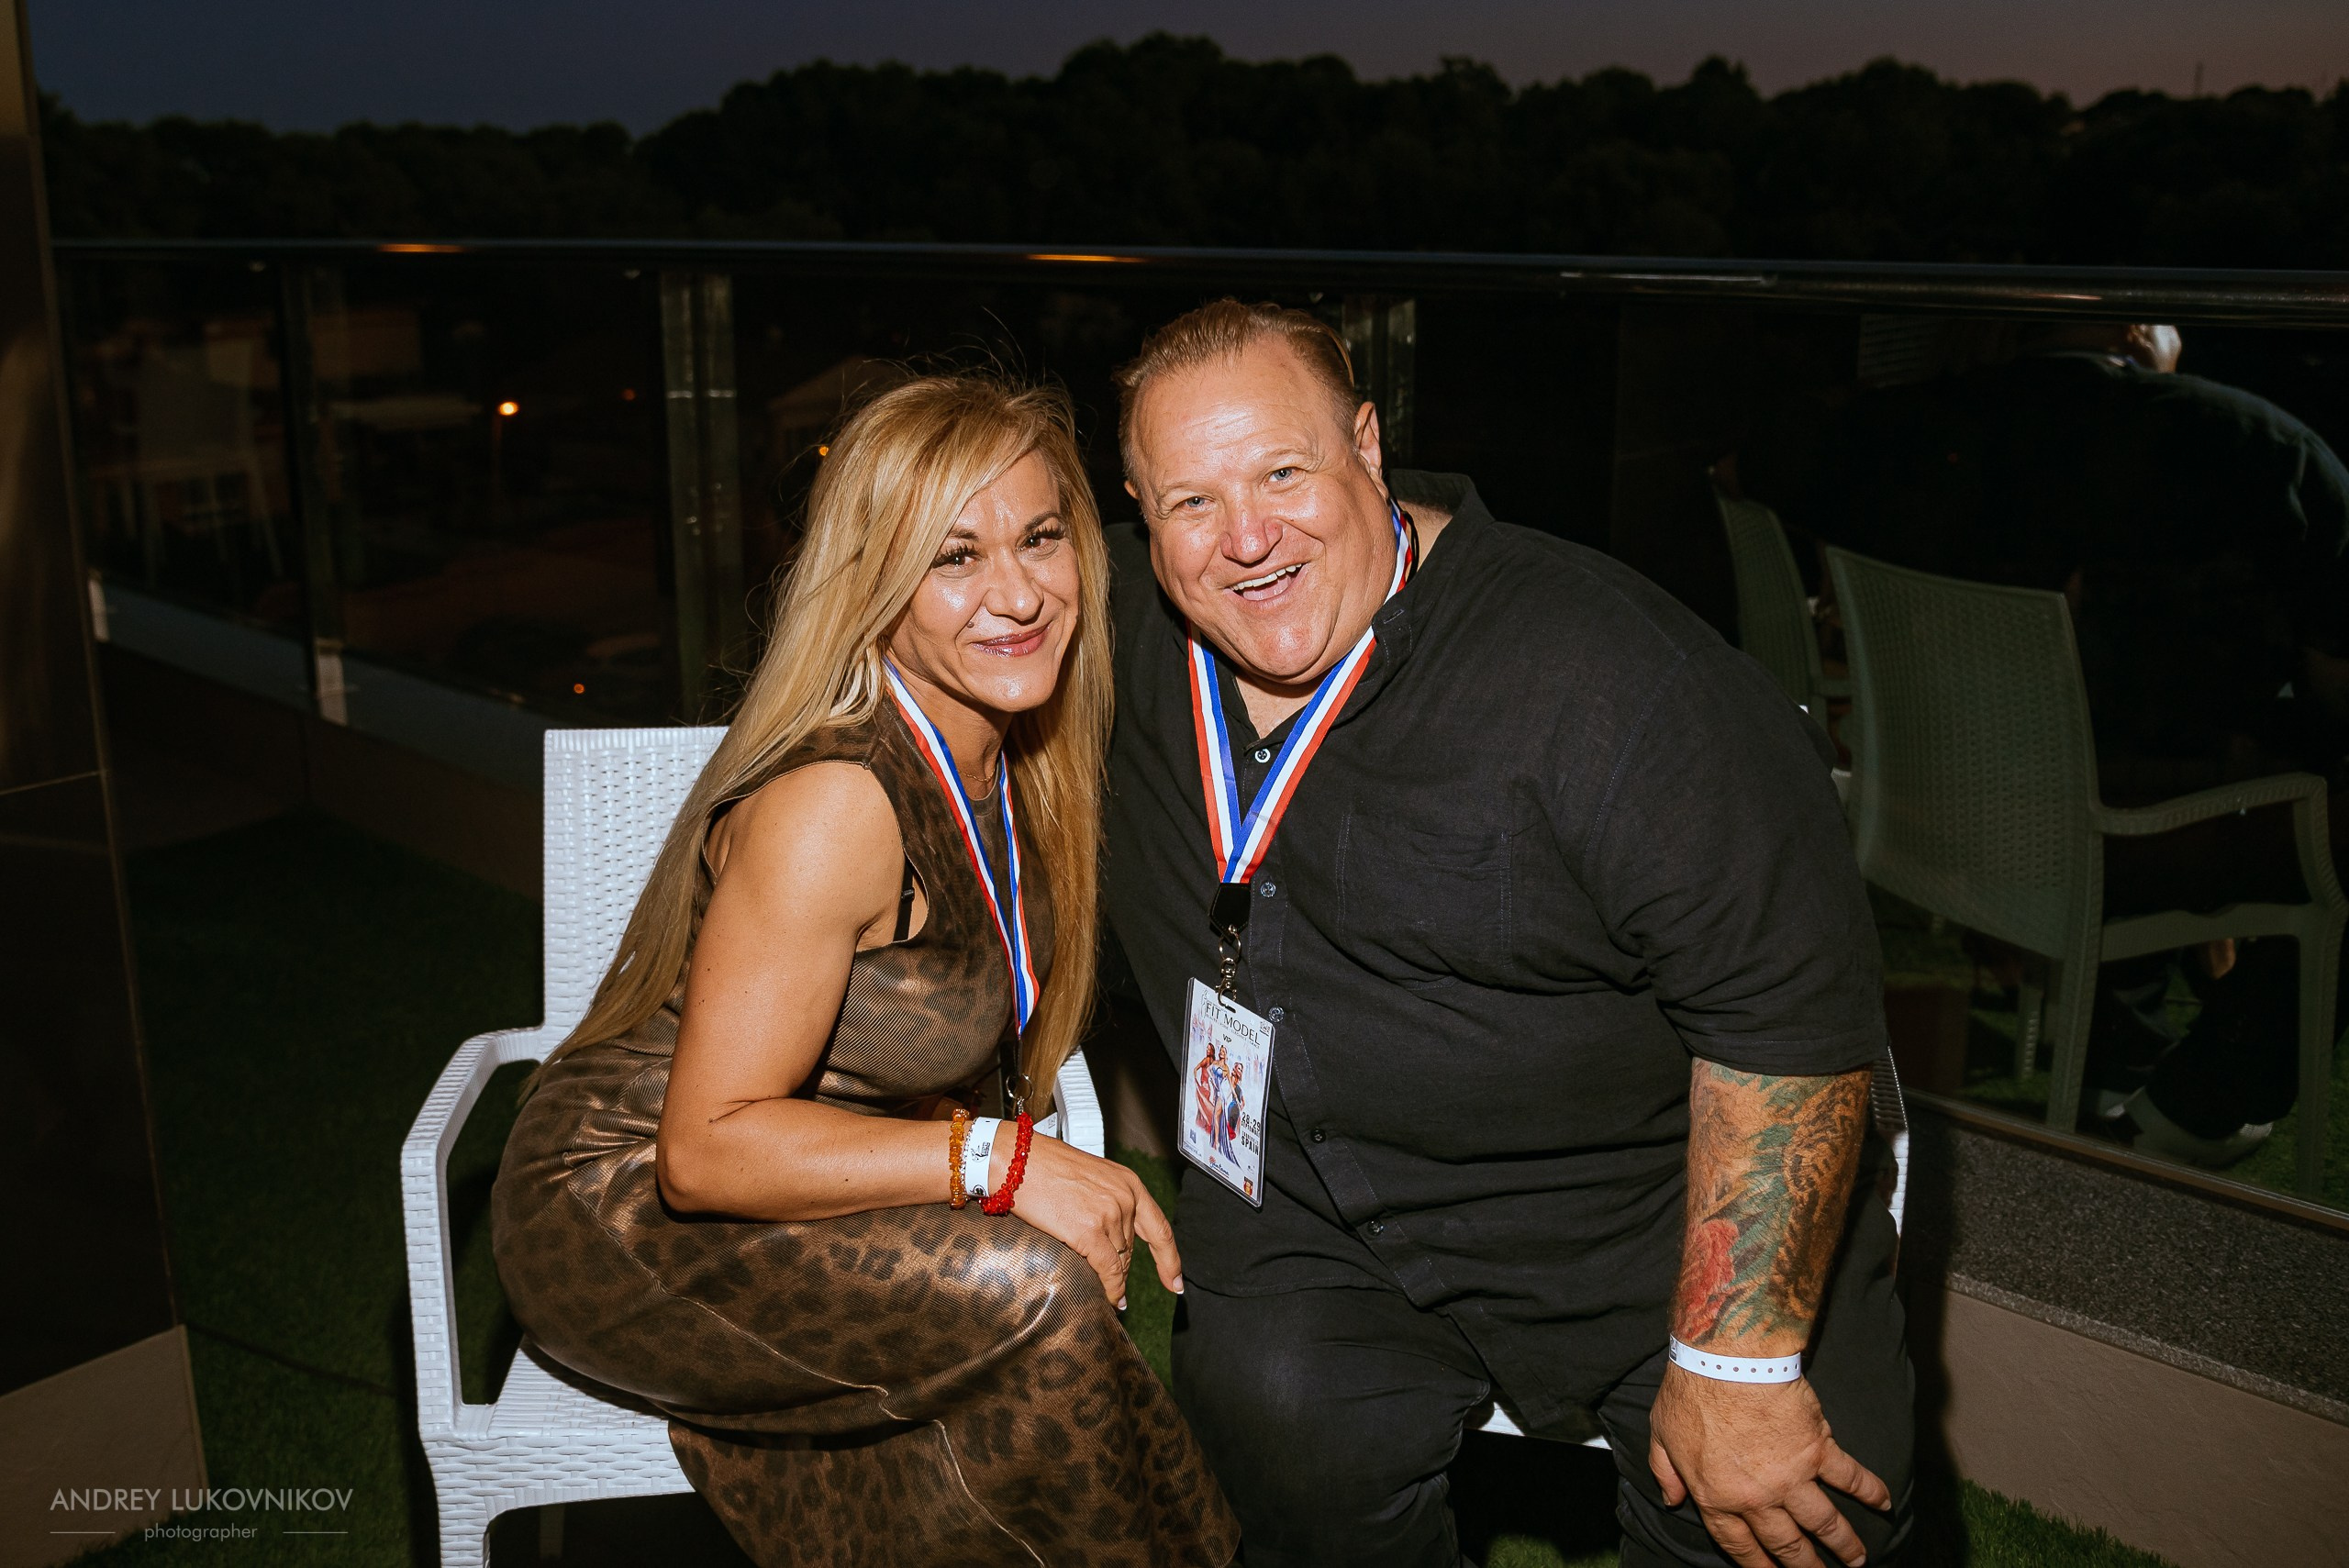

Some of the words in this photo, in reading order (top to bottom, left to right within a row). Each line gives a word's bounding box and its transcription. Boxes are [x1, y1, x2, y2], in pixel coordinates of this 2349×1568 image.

[1206, 1002, 1221, 1019] FIT
[1223, 1013, 1260, 1046] MODEL
[1222, 1033, 1232, 1043] VIP
[1241, 1136, 1259, 1156] SPAIN
